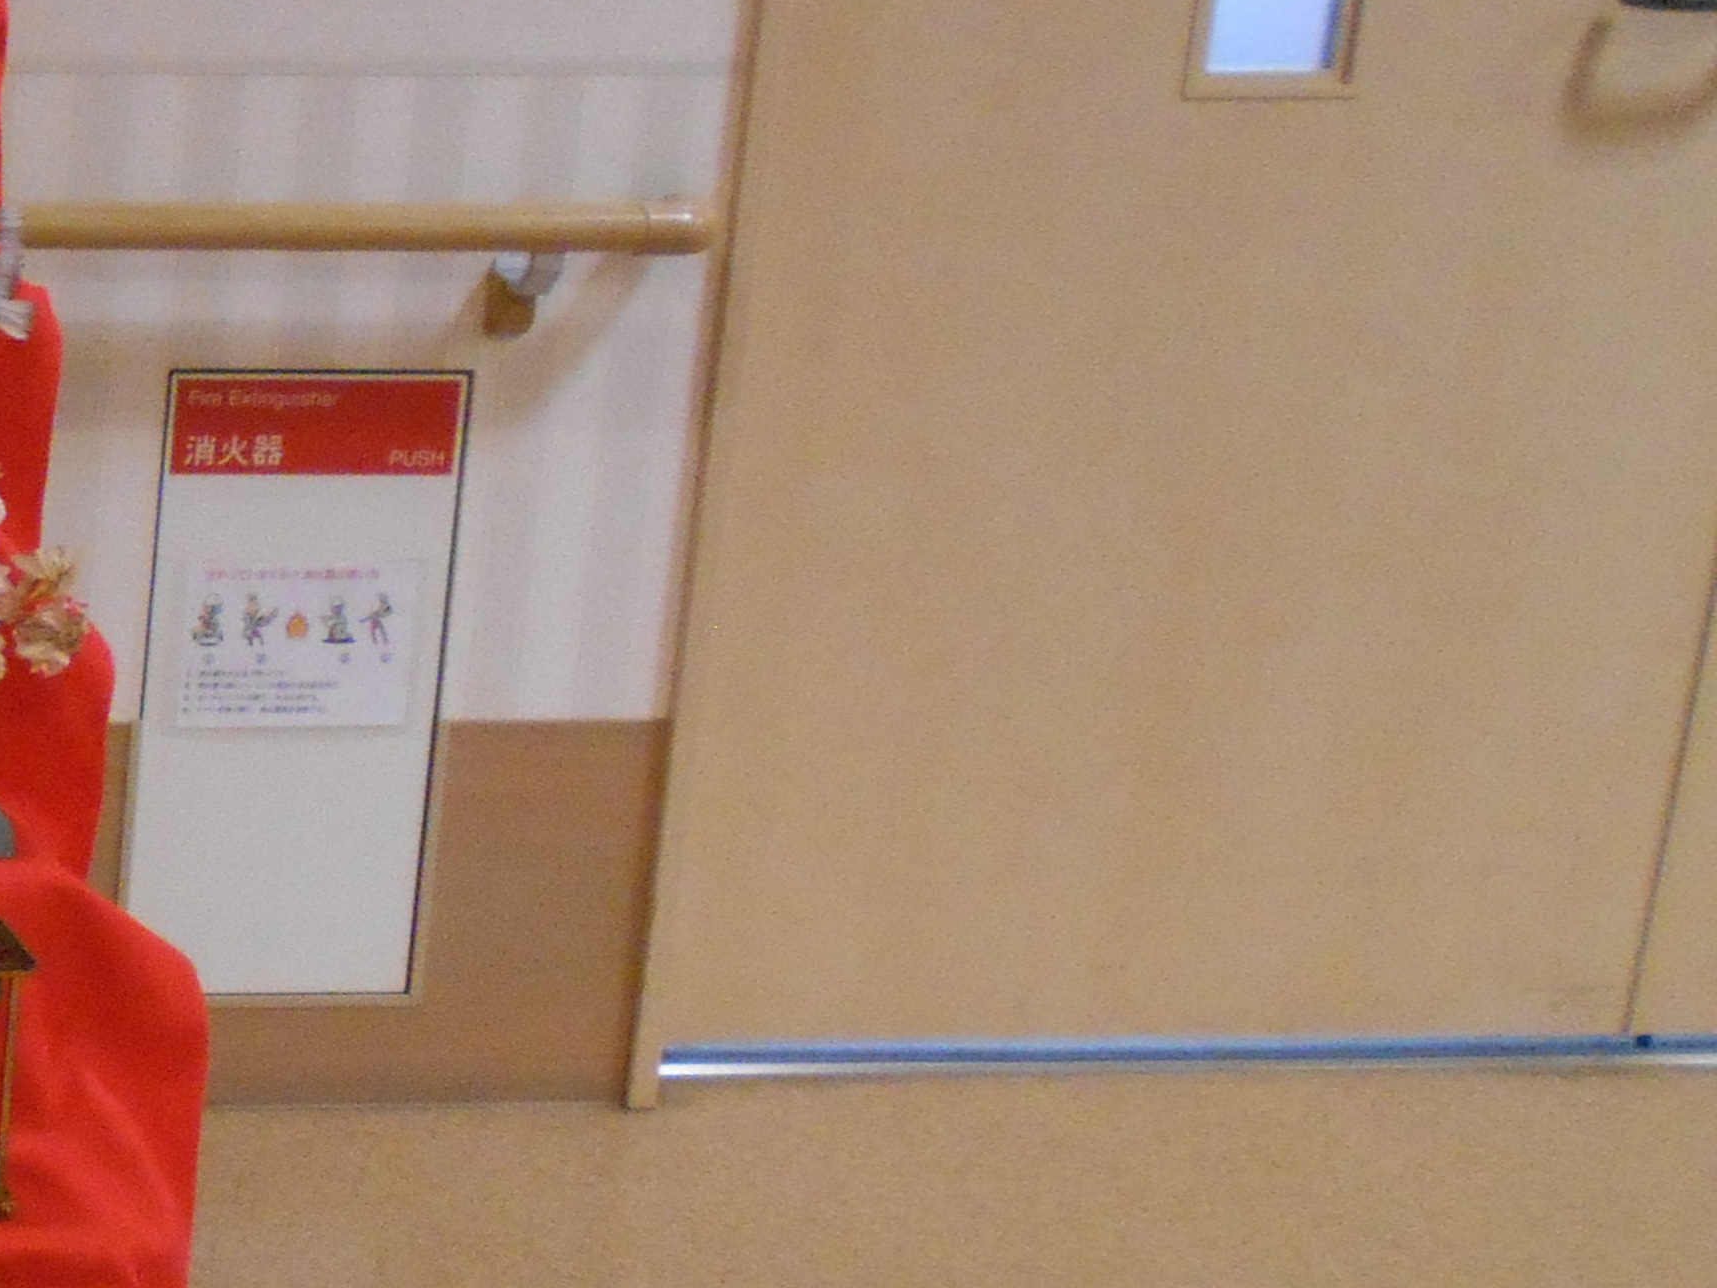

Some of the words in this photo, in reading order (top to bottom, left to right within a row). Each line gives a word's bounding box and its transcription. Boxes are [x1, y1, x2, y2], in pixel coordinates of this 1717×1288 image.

[188, 390, 222, 406] Fire
[229, 389, 339, 410] Extinguisher
[184, 434, 283, 466] 消火器
[389, 449, 446, 467] PUSH
